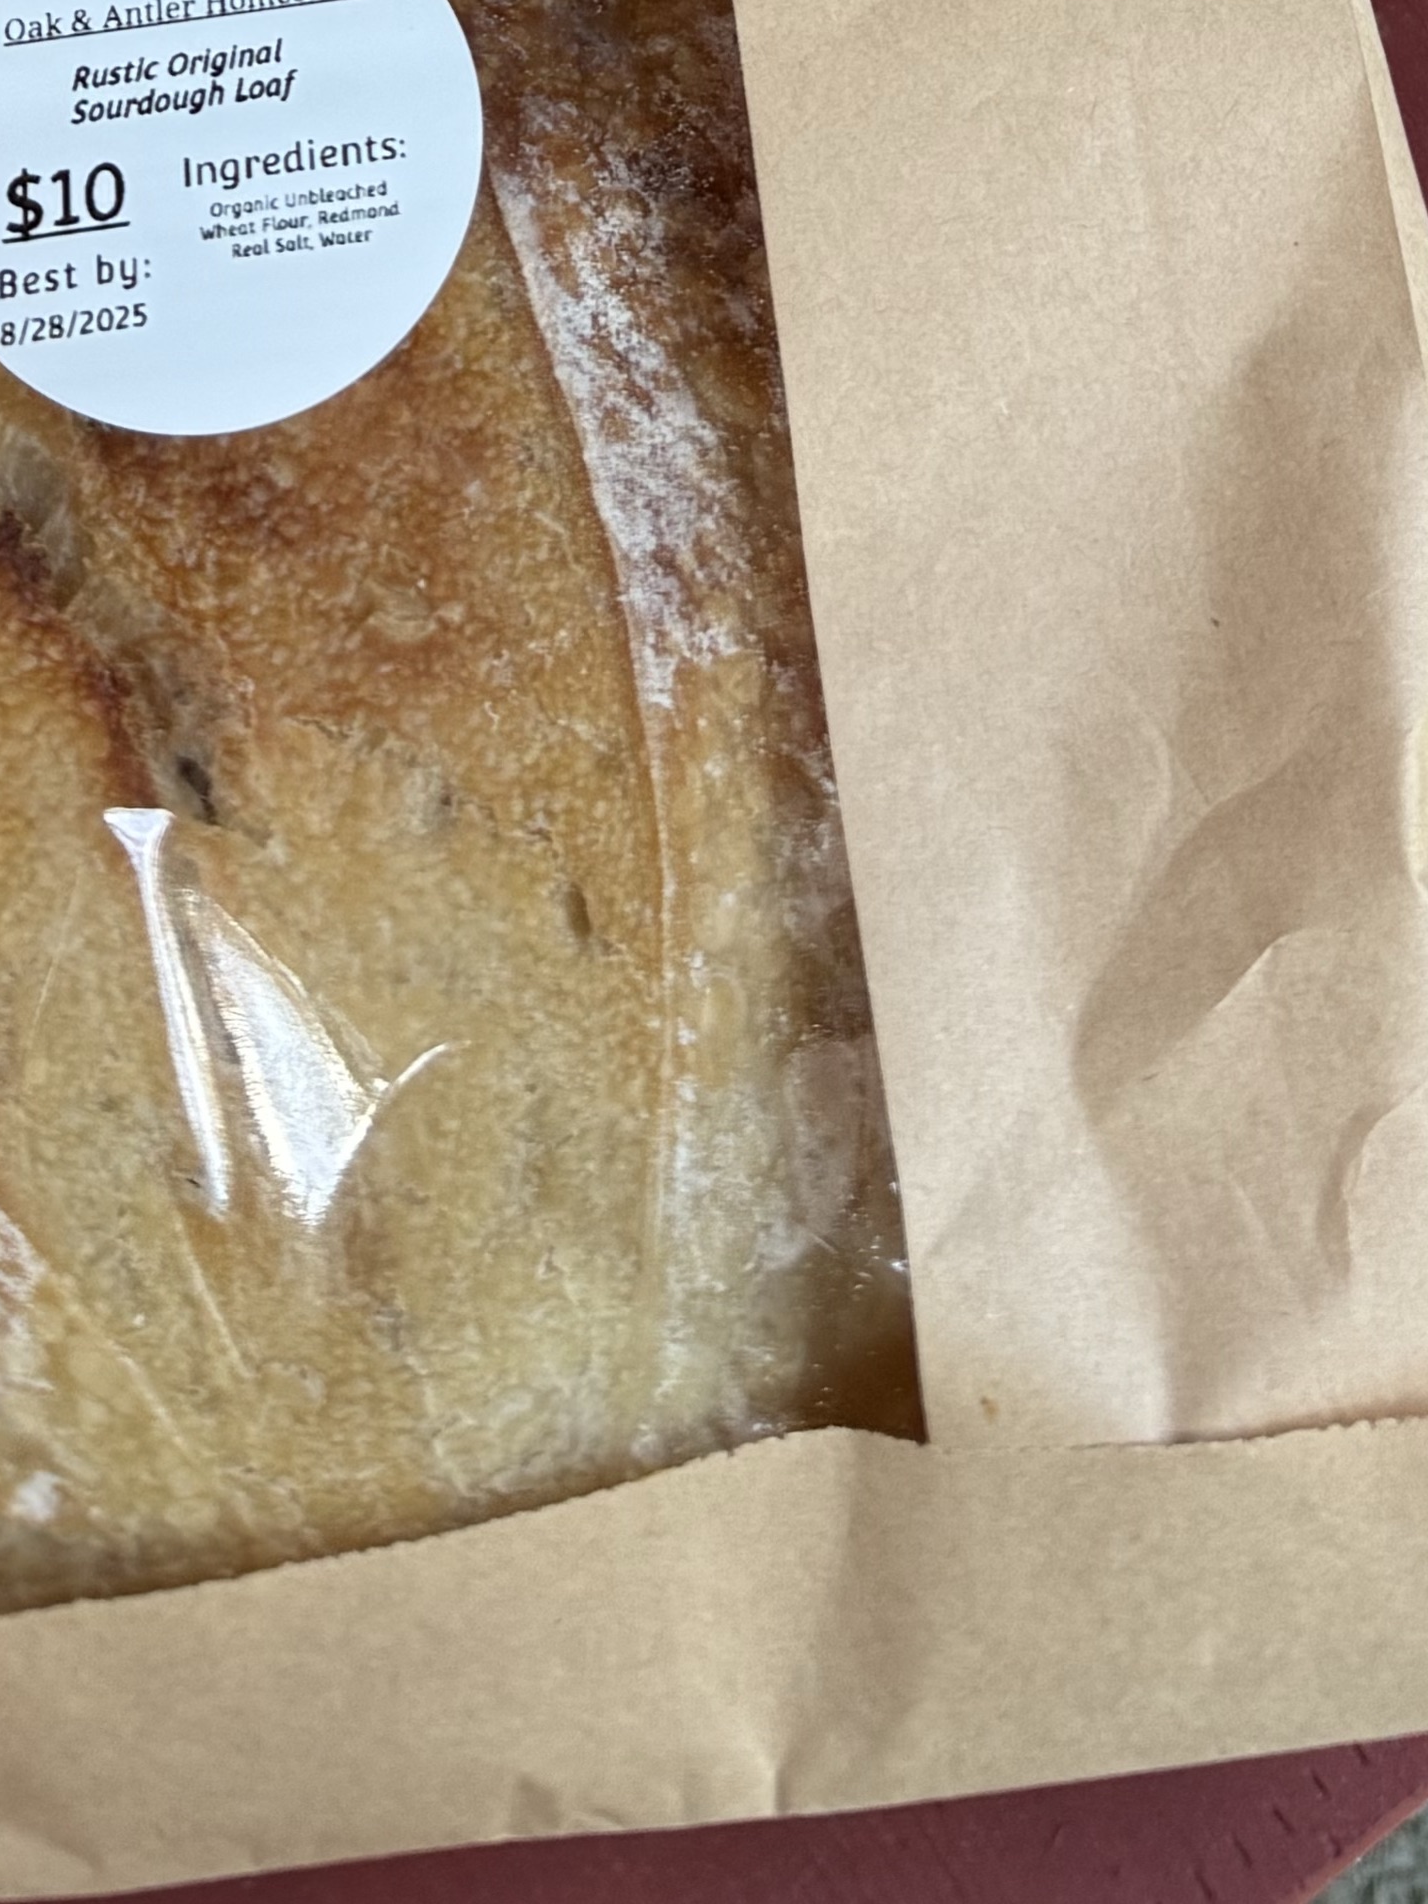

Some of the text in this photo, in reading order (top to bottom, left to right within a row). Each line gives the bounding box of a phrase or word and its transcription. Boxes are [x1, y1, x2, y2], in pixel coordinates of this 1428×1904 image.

[4, 12, 63, 46] Oak
[71, 9, 93, 32] &
[71, 38, 284, 92] Rustic Original
[71, 68, 298, 125] Sourdough Loaf
[182, 132, 407, 190] Ingredients:
[5, 162, 127, 240] $10
[209, 180, 388, 219] Organic Unbleached
[199, 221, 256, 241] Wheat
[318, 200, 401, 226] Redmond
[231, 238, 270, 259] Real
[319, 228, 374, 248] Water
[95, 254, 152, 290] by:
